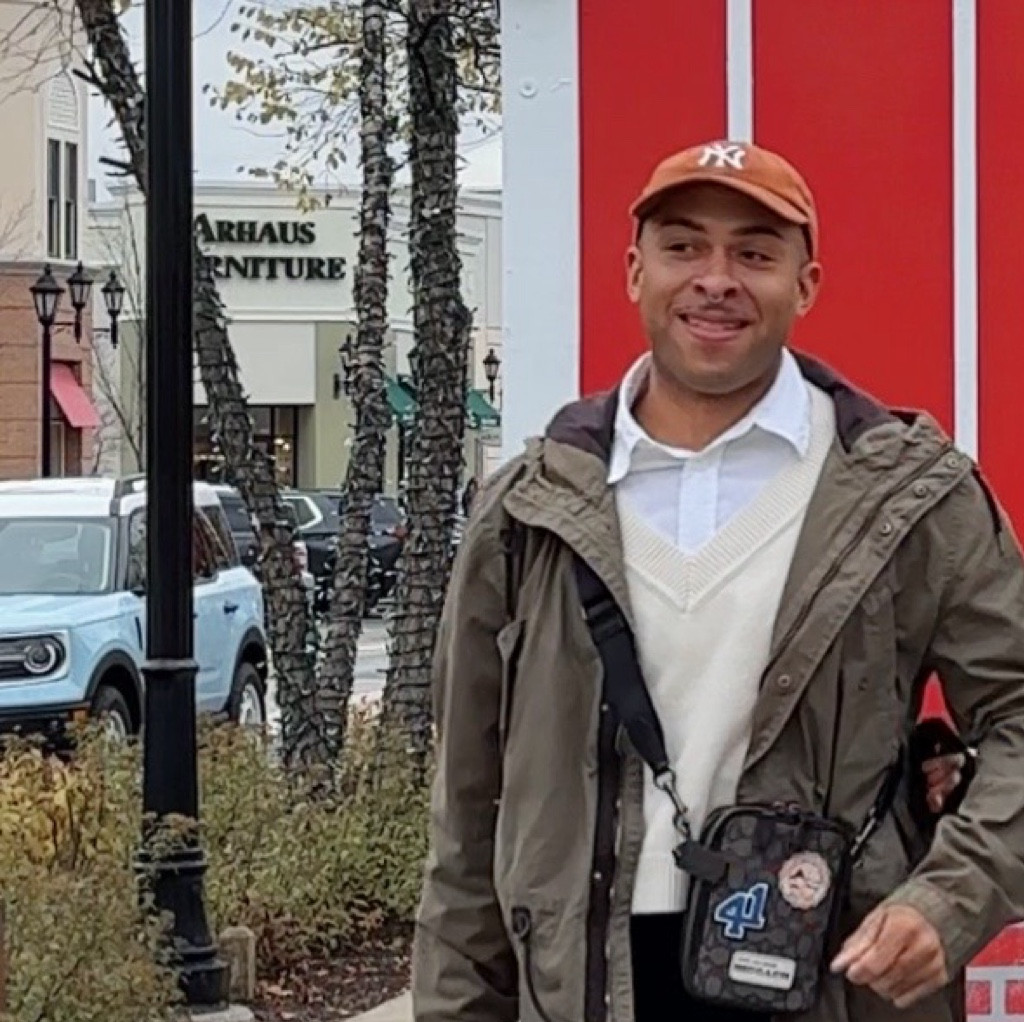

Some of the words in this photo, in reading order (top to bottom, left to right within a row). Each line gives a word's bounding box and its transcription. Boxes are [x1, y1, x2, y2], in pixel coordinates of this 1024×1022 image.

[698, 143, 746, 169] NY
[195, 212, 316, 244] ARHAUS
[204, 255, 347, 281] RNITURE
[714, 883, 770, 939] 41
